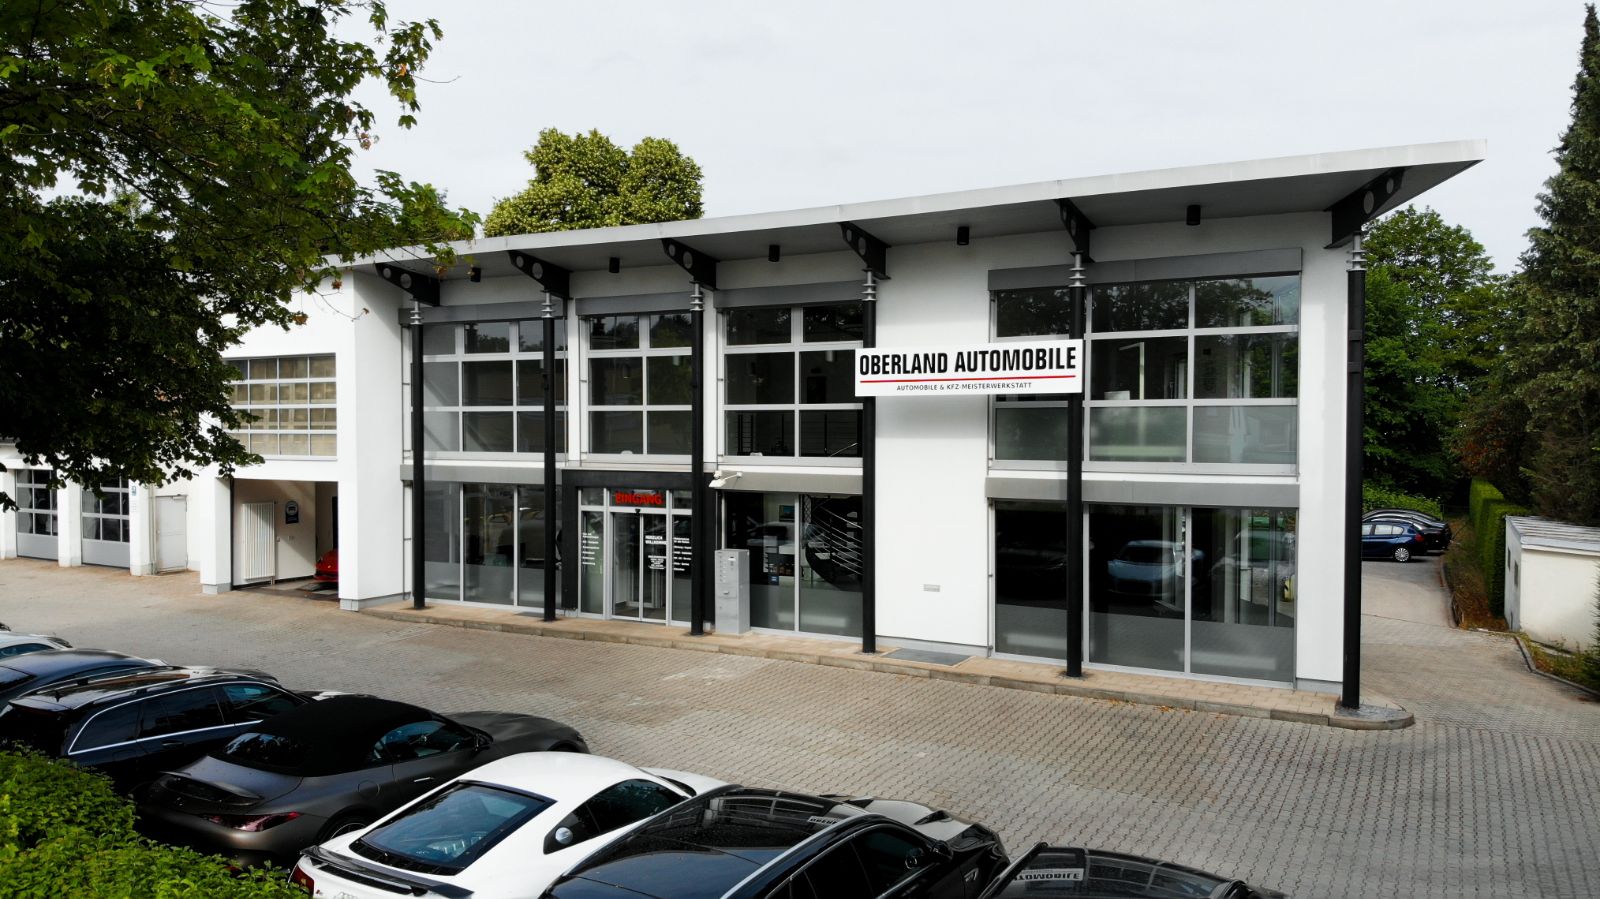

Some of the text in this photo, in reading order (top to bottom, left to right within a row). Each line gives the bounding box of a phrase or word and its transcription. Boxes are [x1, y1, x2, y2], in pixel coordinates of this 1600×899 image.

[860, 347, 1076, 375] OBERLAND AUTOMOBILE
[615, 492, 662, 505] EINGANG
